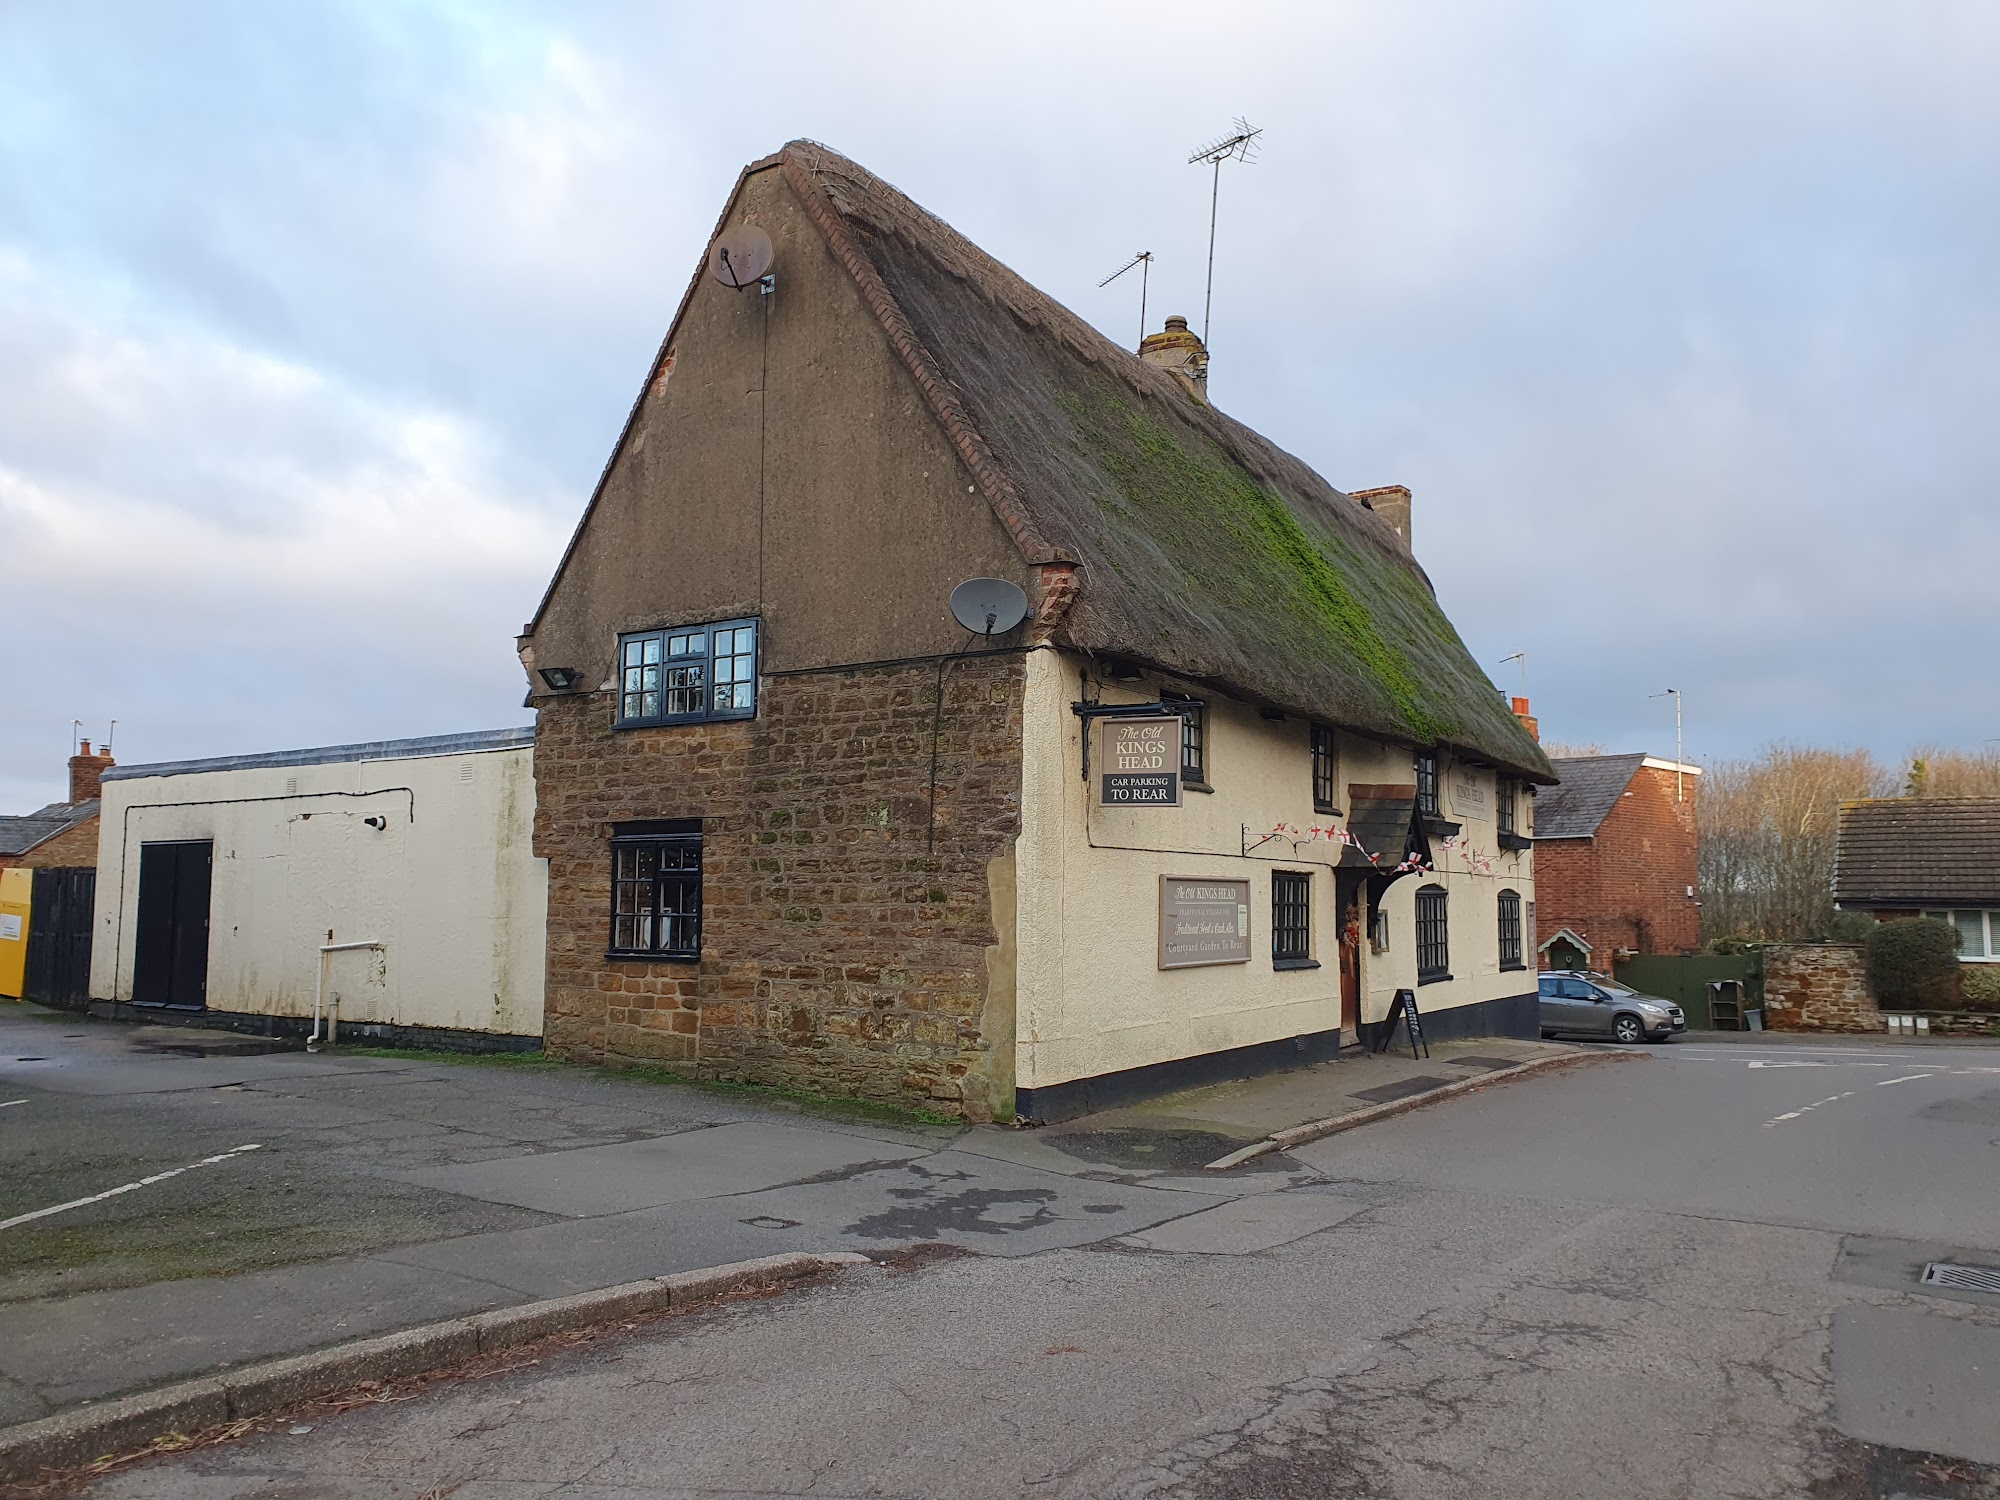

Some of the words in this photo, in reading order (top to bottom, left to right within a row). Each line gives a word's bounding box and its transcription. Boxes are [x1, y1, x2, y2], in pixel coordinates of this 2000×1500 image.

[1118, 726, 1139, 740] The
[1141, 726, 1164, 740] Old
[1115, 741, 1166, 754] KINGS
[1118, 756, 1163, 769] HEAD
[1111, 778, 1129, 786] CAR
[1130, 777, 1168, 786] PARKING
[1111, 789, 1129, 800] TO
[1132, 788, 1168, 800] REAR
[1197, 887, 1218, 899] KINGS
[1218, 888, 1236, 899] HEAD
[1168, 941, 1198, 955] Courtyard
[1200, 940, 1220, 951] Garden
[1222, 939, 1229, 950] To
[1230, 939, 1243, 950] Rear
